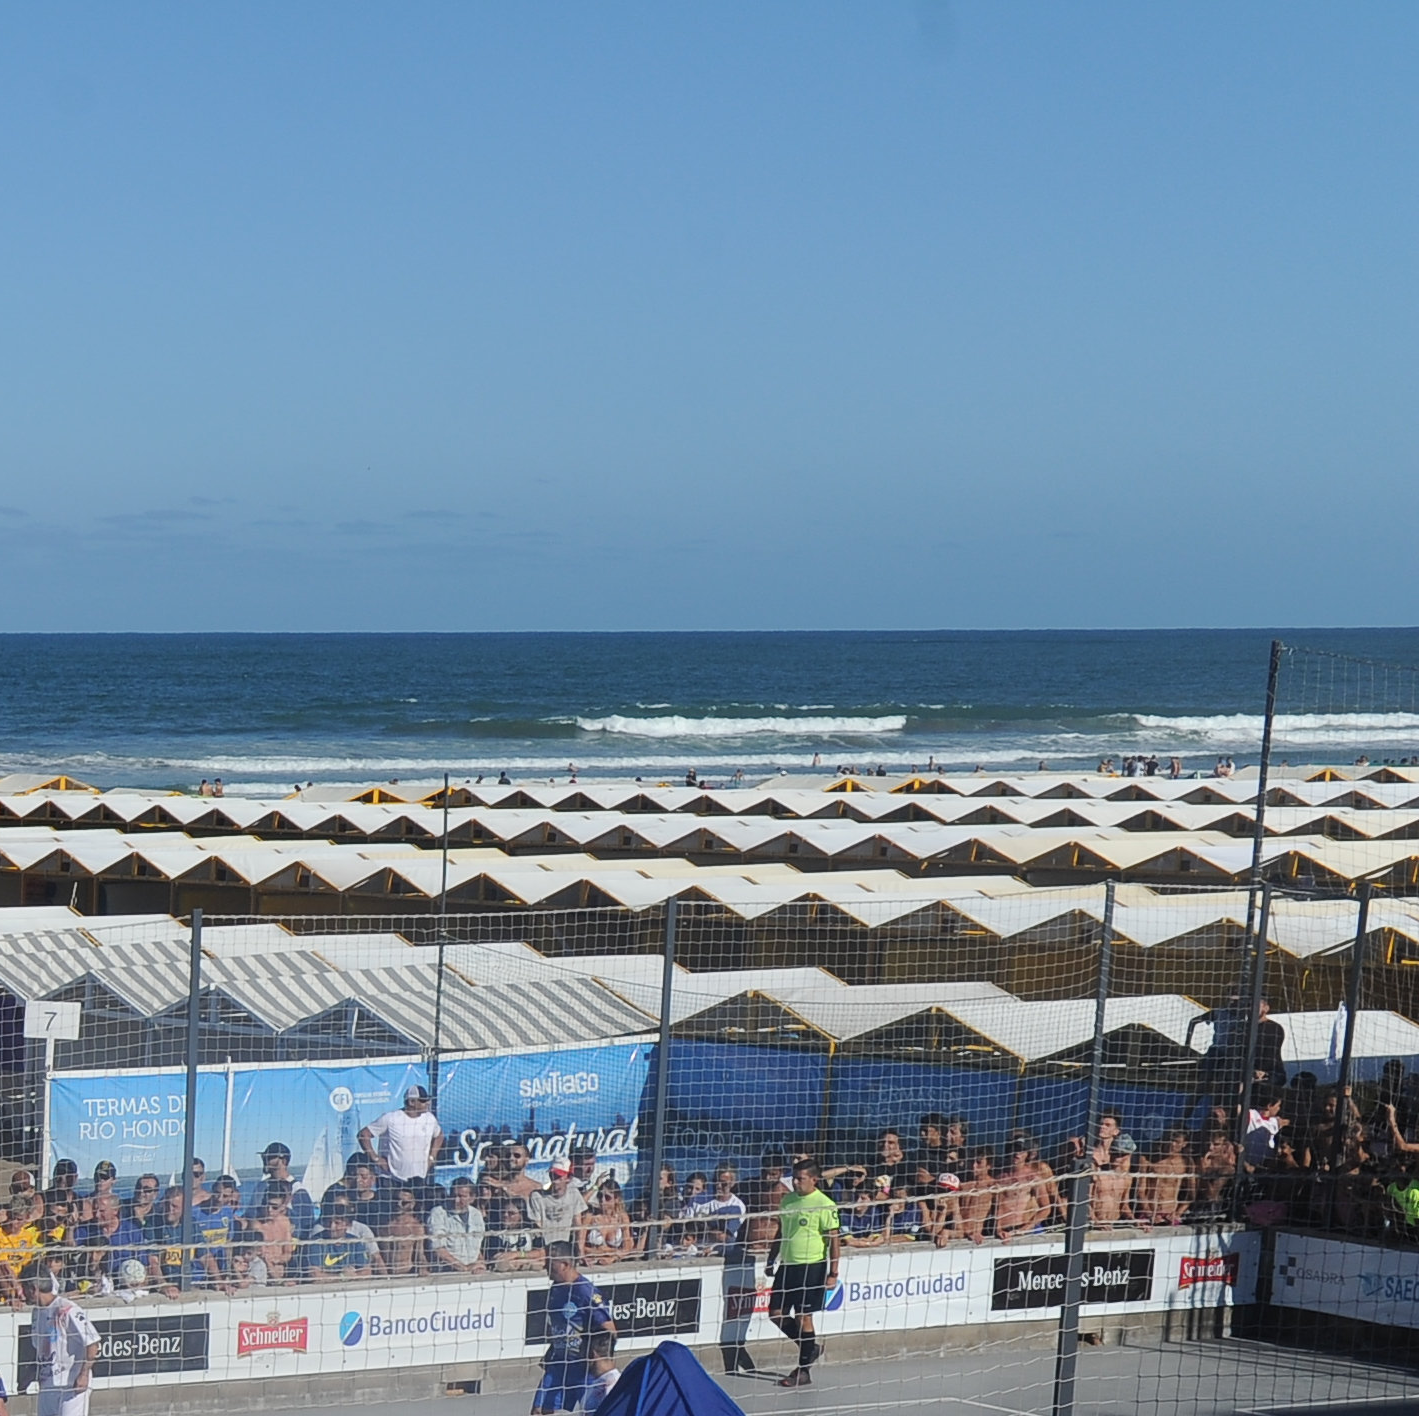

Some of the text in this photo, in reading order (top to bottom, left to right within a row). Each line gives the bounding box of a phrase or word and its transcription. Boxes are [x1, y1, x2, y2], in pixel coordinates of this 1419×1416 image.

[44, 1011, 58, 1031] 7
[83, 1096, 161, 1117] TERMAS
[79, 1118, 186, 1140] RÍO HOND
[849, 1271, 966, 1302] BancoCiudad
[1018, 1265, 1131, 1292] Merces-Benz
[369, 1307, 496, 1338] BancoCiudad
[241, 1327, 304, 1347] Schneider
